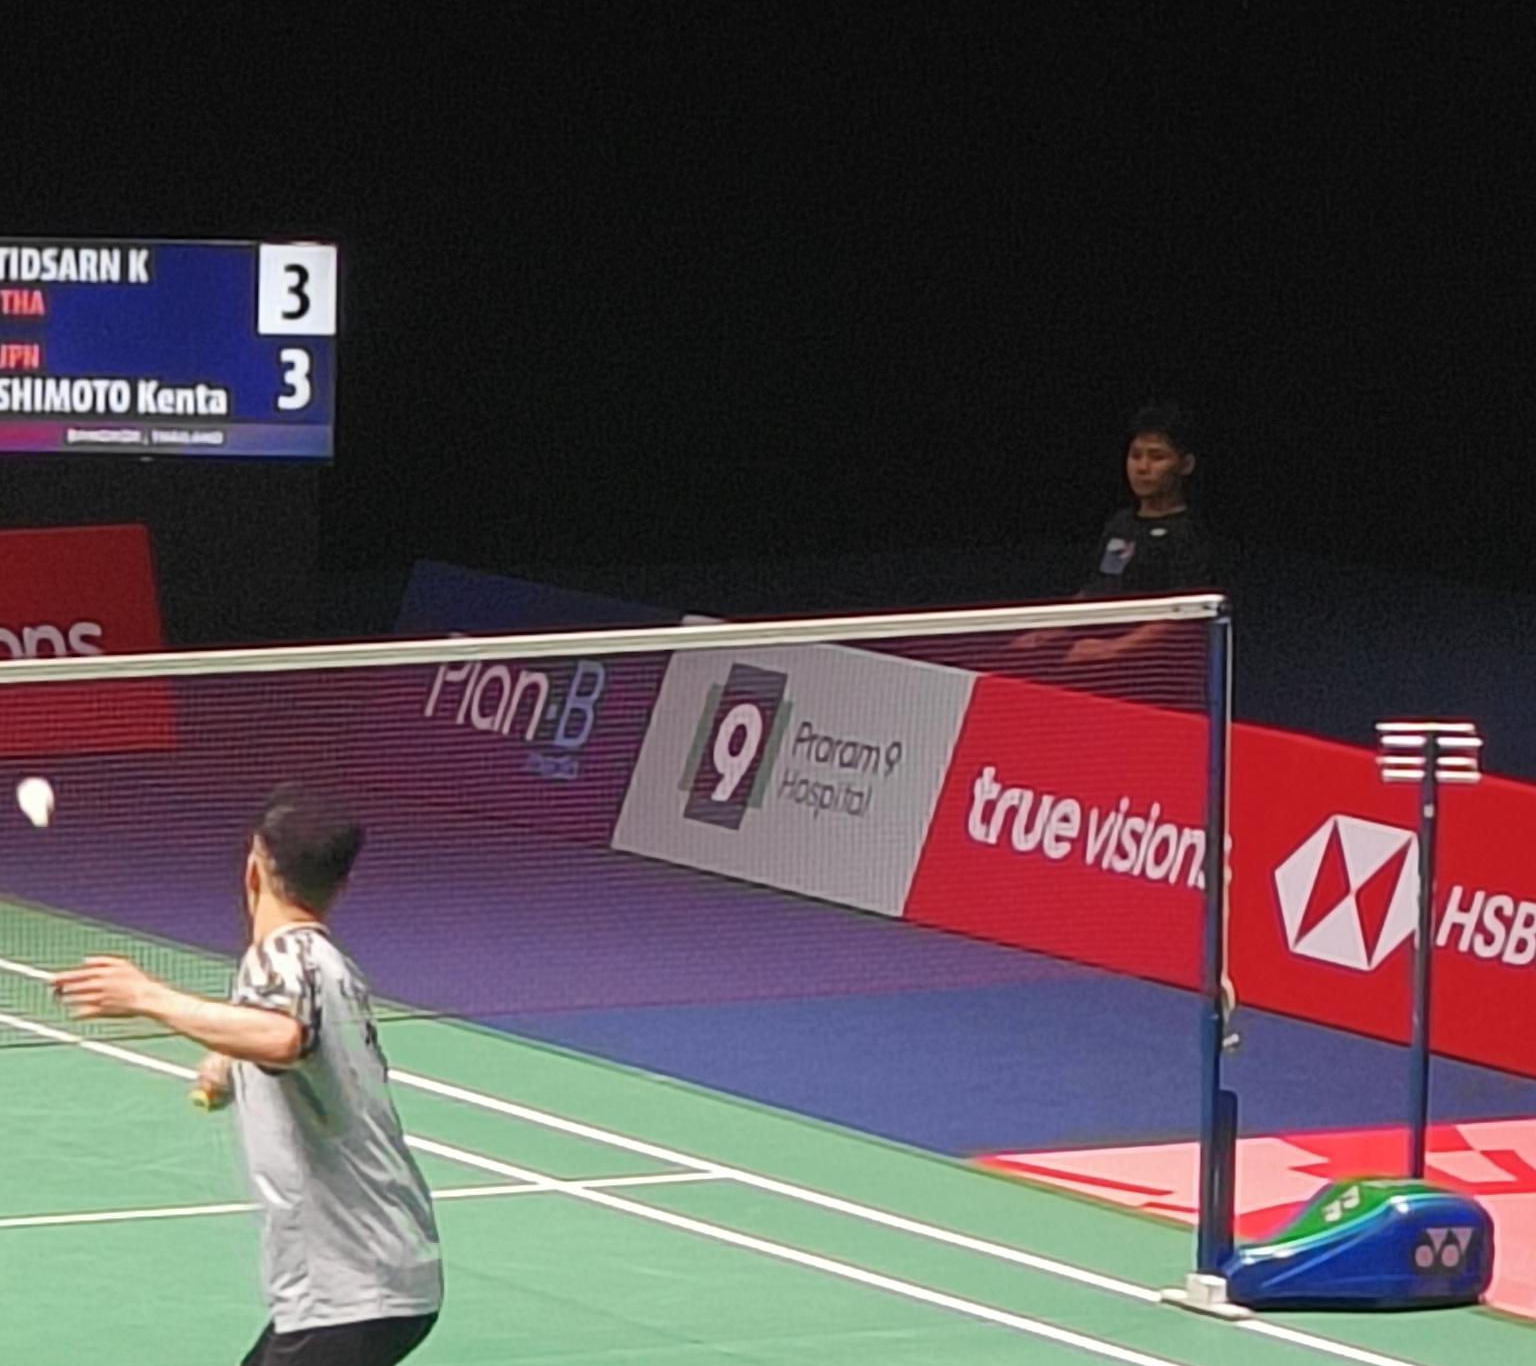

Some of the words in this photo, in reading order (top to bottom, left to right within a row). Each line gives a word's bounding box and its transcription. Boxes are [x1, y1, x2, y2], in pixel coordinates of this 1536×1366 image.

[128, 248, 149, 284] K
[281, 263, 311, 321] 3
[0, 289, 45, 316] THA
[137, 379, 228, 415] Kenta
[277, 348, 312, 410] 3
[711, 703, 763, 801] 9
[777, 768, 872, 819] Hospital
[968, 766, 1081, 859] true
